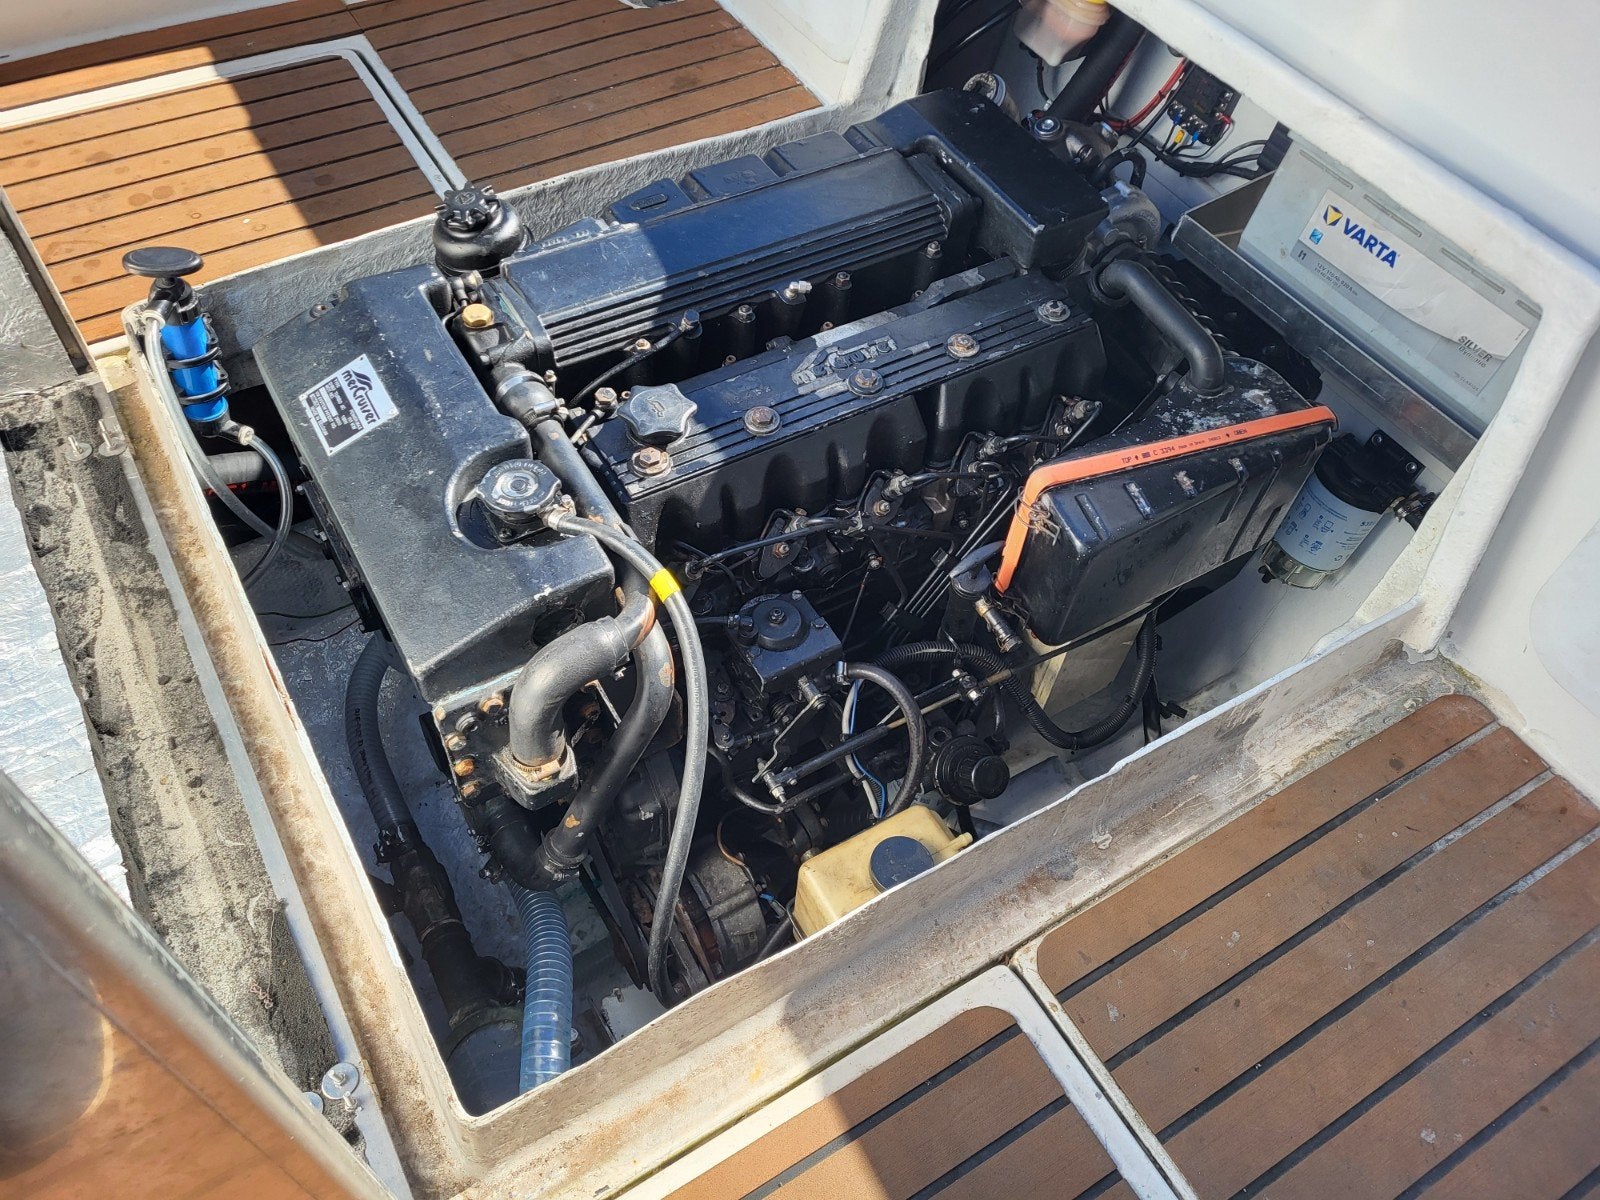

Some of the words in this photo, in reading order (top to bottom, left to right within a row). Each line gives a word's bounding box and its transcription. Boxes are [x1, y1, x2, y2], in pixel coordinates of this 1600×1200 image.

[1343, 217, 1397, 268] VARTA
[1458, 336, 1493, 363] SILVER
[1121, 456, 1132, 464] TOP
